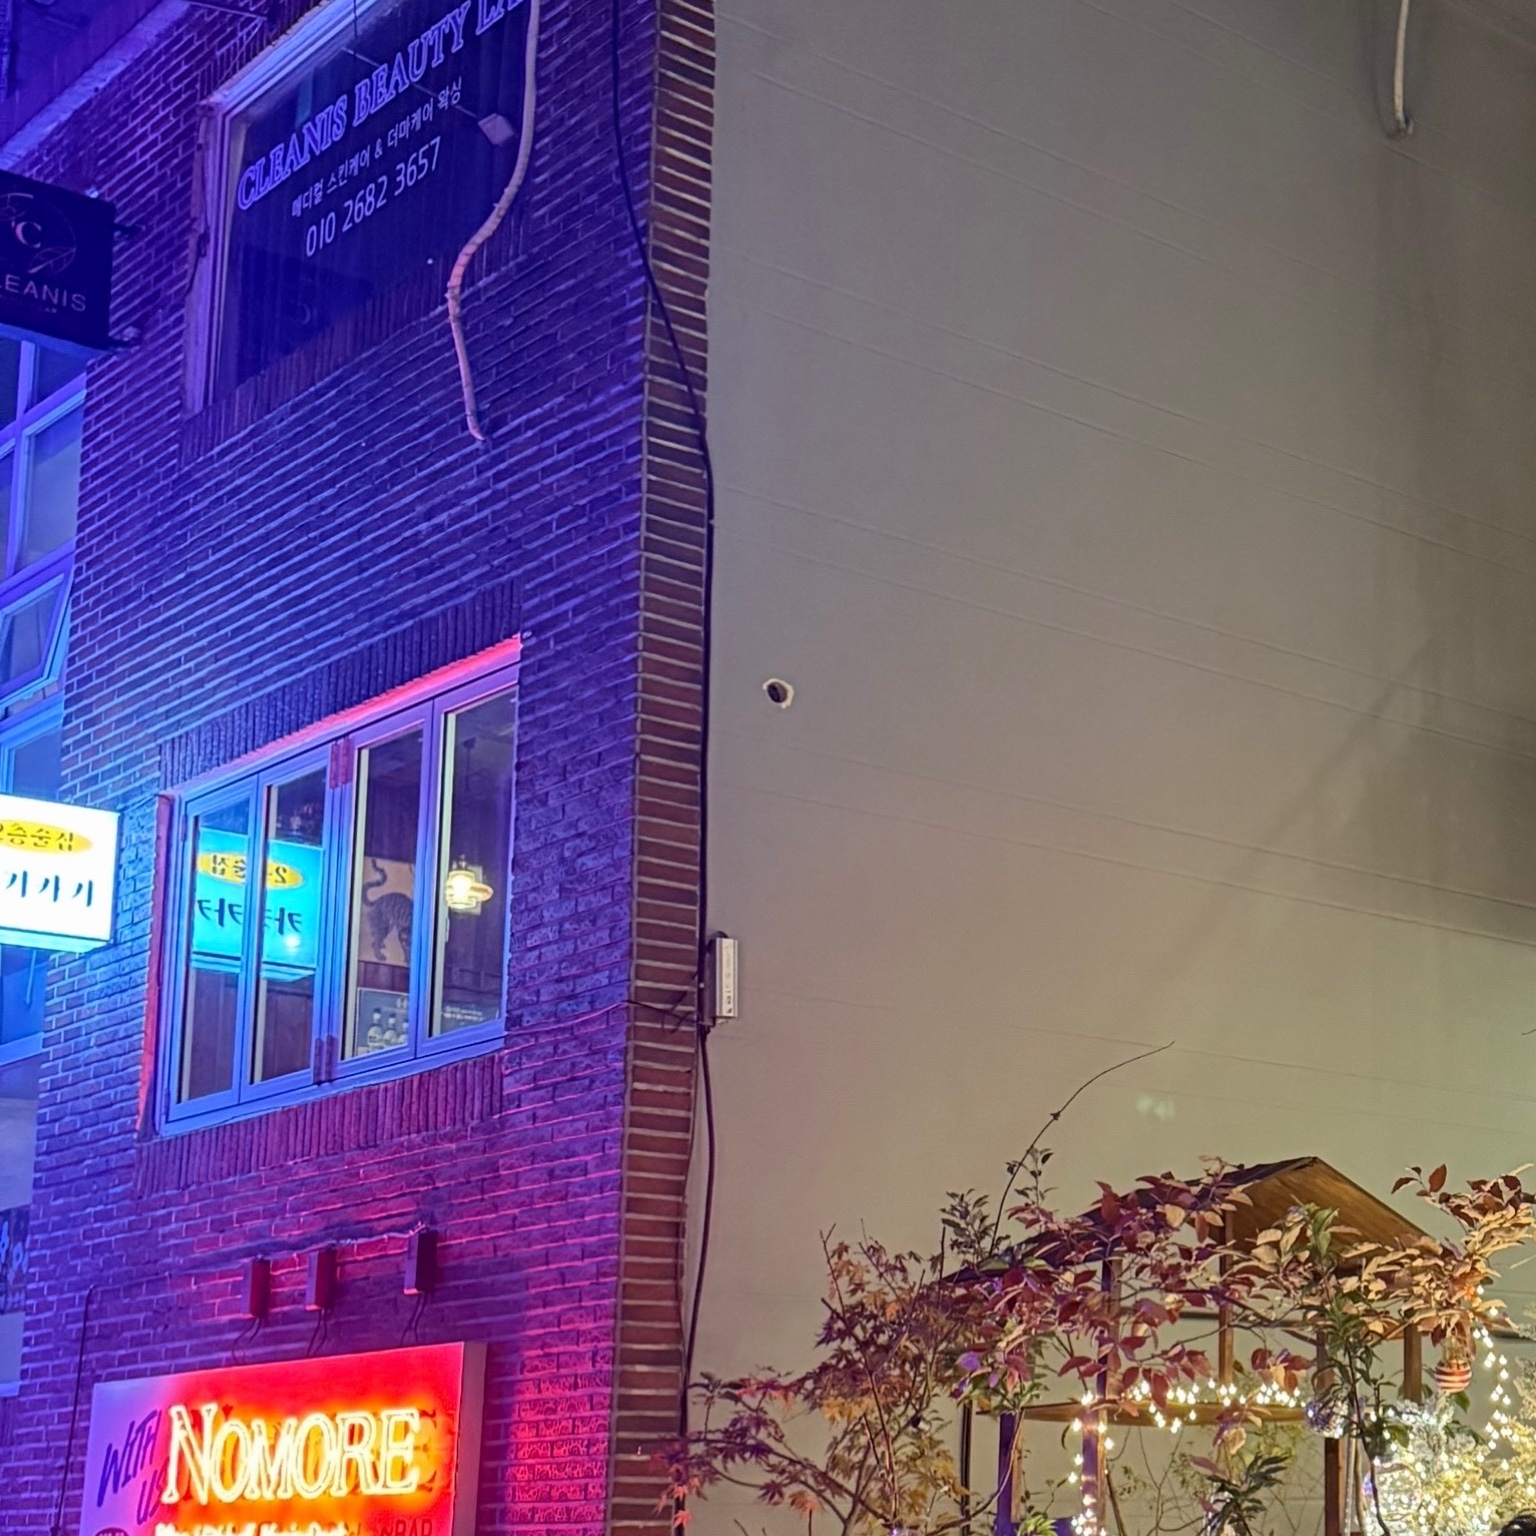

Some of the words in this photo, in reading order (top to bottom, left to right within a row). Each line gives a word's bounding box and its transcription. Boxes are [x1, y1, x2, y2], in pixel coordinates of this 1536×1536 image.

[237, 94, 347, 210] CLEANIS
[352, 0, 471, 127] BEAUTY
[475, 0, 524, 36] L
[326, 144, 370, 194] 스킨케어
[375, 138, 383, 159] &
[387, 97, 434, 147] 더마케어
[438, 76, 462, 110] 왁싱
[306, 212, 335, 257] 010
[342, 175, 387, 232] 2682
[394, 136, 441, 196] 3657
[0, 273, 86, 312] EANIS
[97, 1409, 163, 1508] WITH
[161, 1403, 421, 1506] NOMORE
